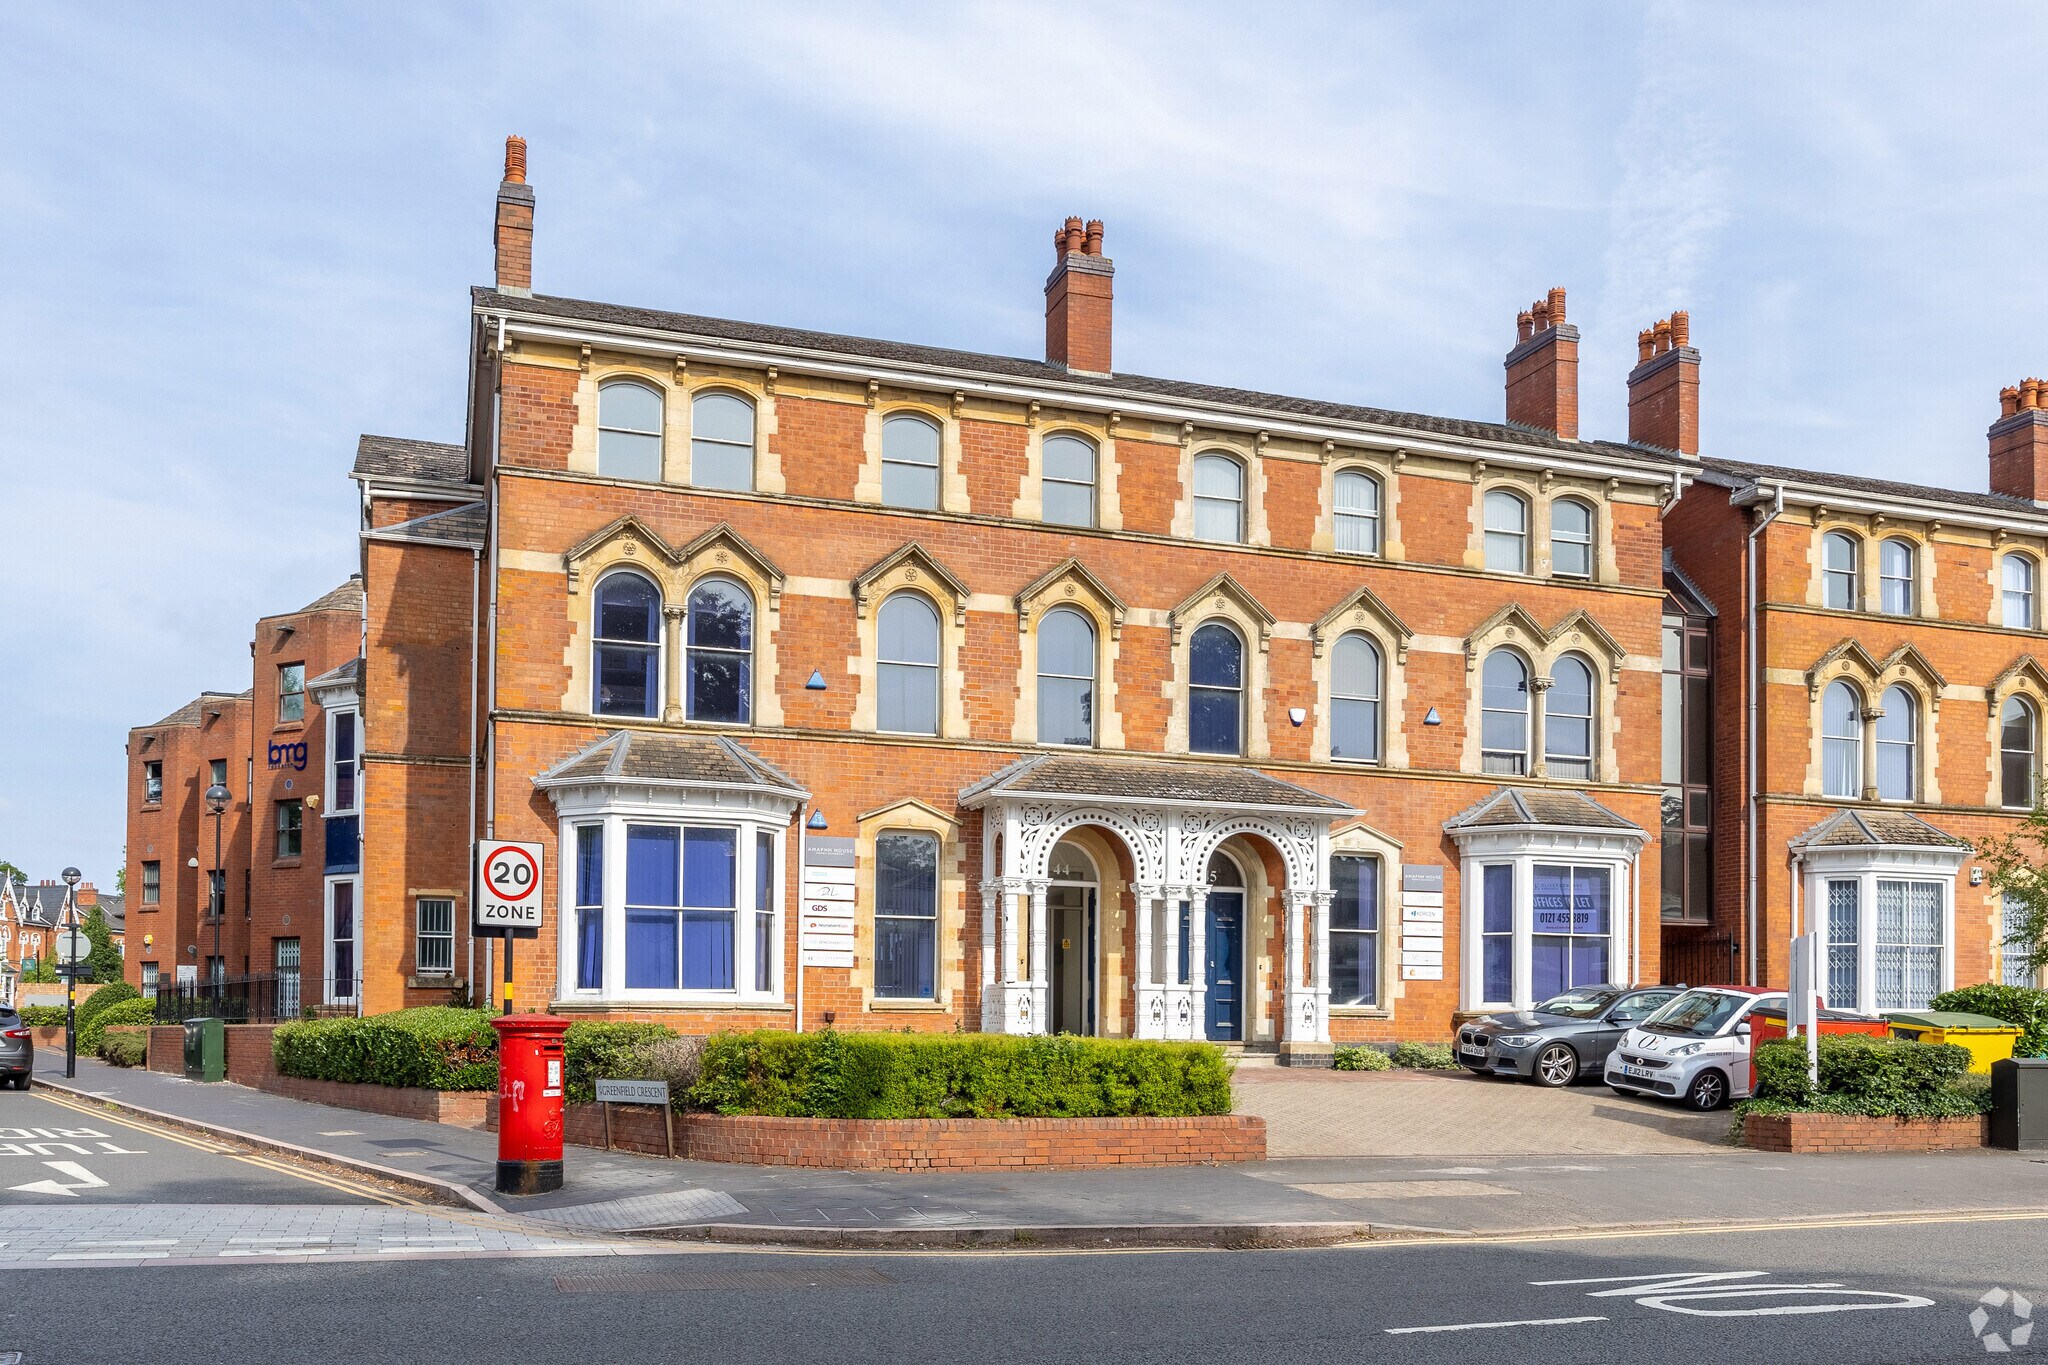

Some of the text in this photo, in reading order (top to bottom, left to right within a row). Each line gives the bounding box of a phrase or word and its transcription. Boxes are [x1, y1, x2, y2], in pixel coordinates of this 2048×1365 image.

[268, 739, 308, 772] bmg
[493, 862, 531, 885] 20
[1053, 863, 1070, 876] 44
[811, 904, 828, 912] GDS
[1575, 897, 1591, 908] LET
[486, 904, 535, 920] ZONE
[1540, 912, 1555, 923] 0121
[1557, 912, 1571, 923] 455
[1641, 1069, 1654, 1078] LRV
[602, 1085, 667, 1098] GREENFIELD CRESCENT
